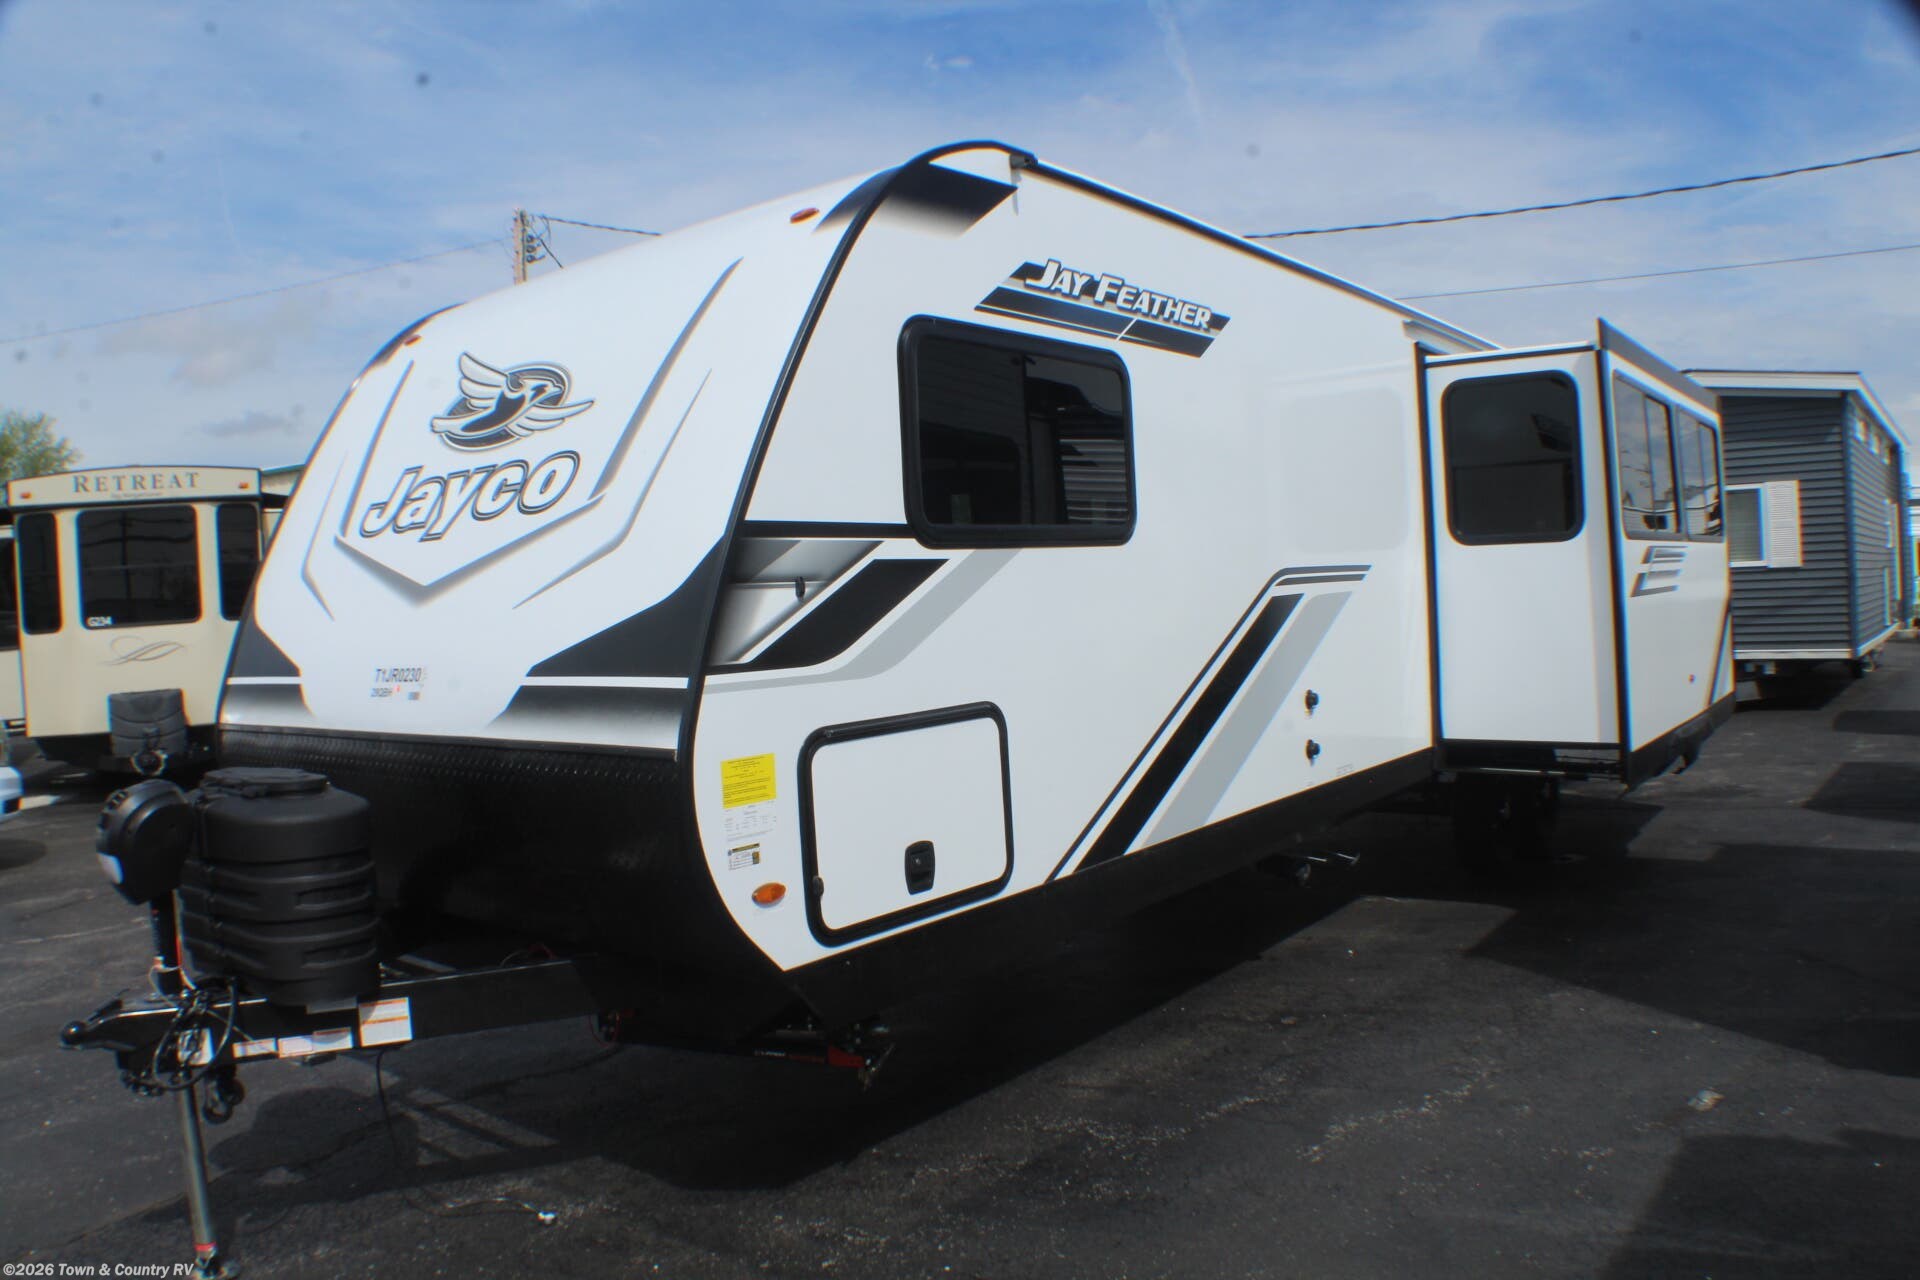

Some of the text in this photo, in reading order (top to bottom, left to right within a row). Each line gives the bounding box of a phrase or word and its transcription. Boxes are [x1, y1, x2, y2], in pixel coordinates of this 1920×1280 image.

[1024, 258, 1213, 332] JAY FEATHER
[72, 471, 199, 493] RETREAT
[359, 450, 581, 543] Jayco
